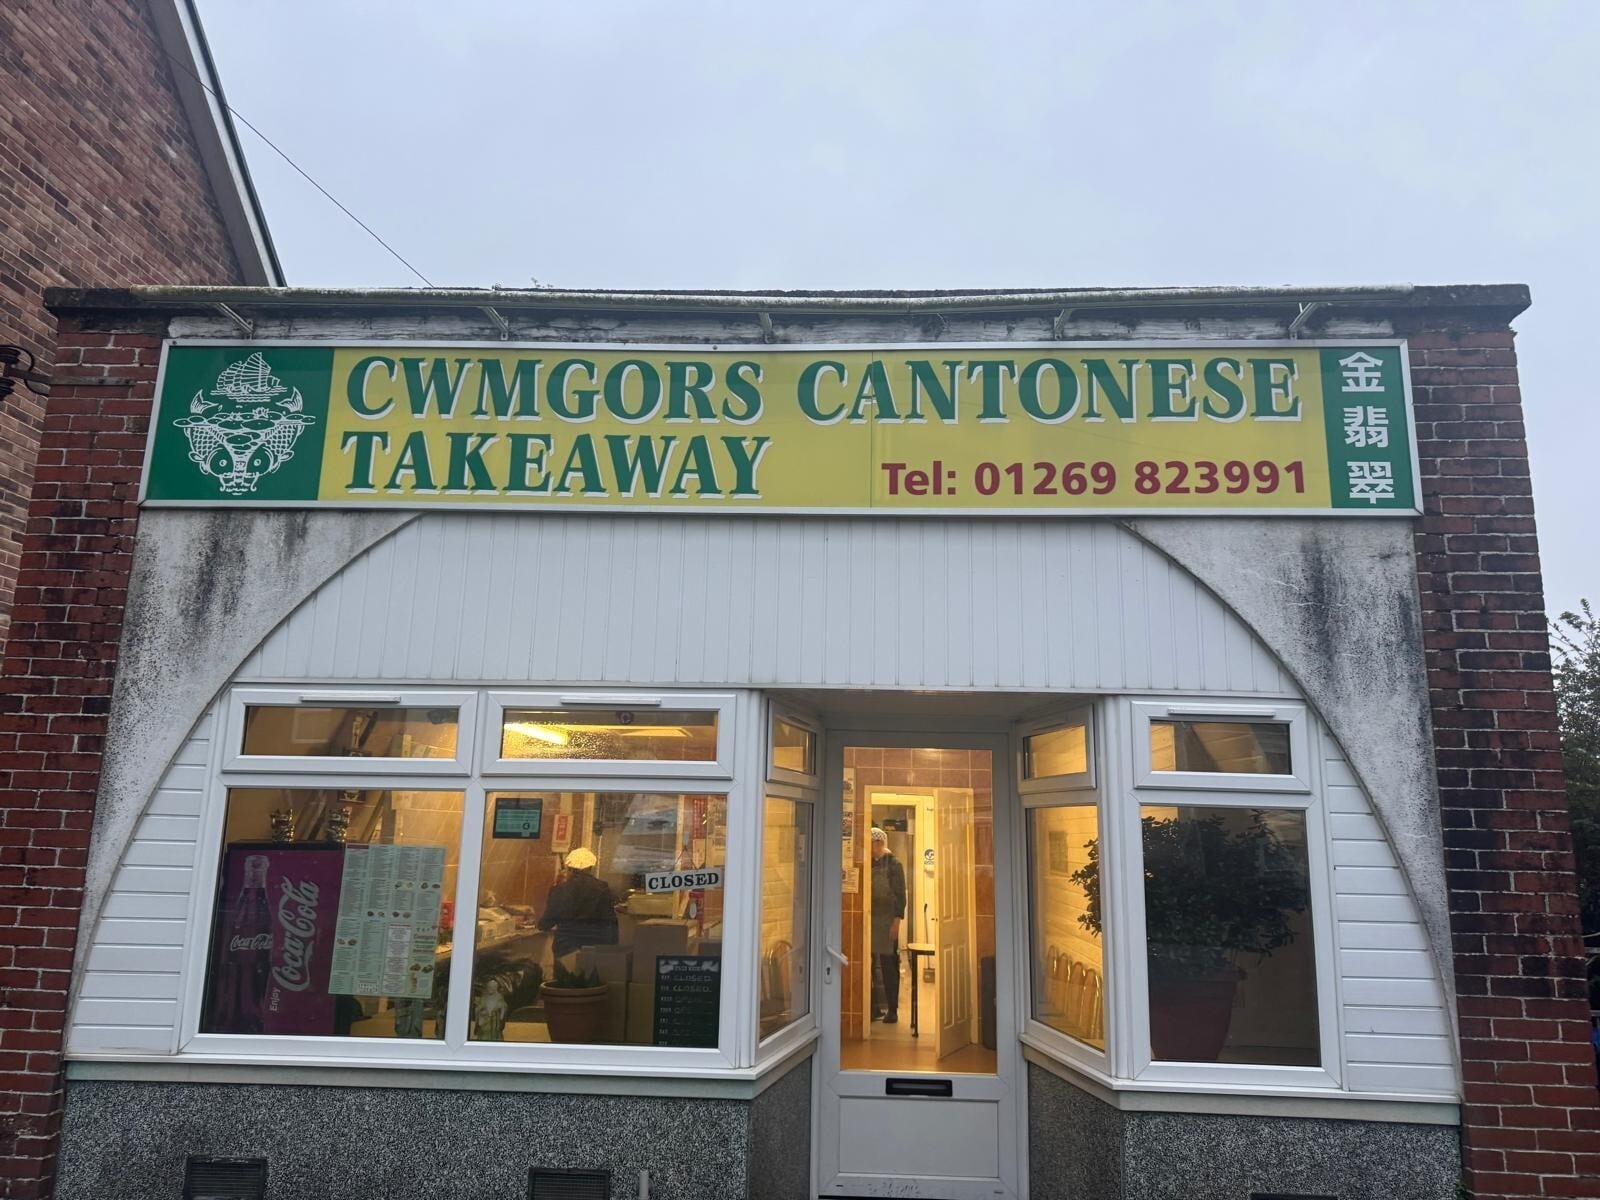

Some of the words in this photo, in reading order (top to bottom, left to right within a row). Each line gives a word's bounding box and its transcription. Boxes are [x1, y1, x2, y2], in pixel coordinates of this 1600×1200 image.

[346, 356, 764, 424] CWMGORS
[797, 356, 1303, 425] CANTONESE
[1338, 350, 1396, 504] 金翡翠
[341, 431, 772, 498] TAKEAWAY
[882, 460, 957, 496] Tel:
[974, 461, 1117, 496] 01269
[1134, 460, 1306, 495] 823991
[648, 872, 719, 890] CLOSED
[269, 987, 281, 1012] Enjoy
